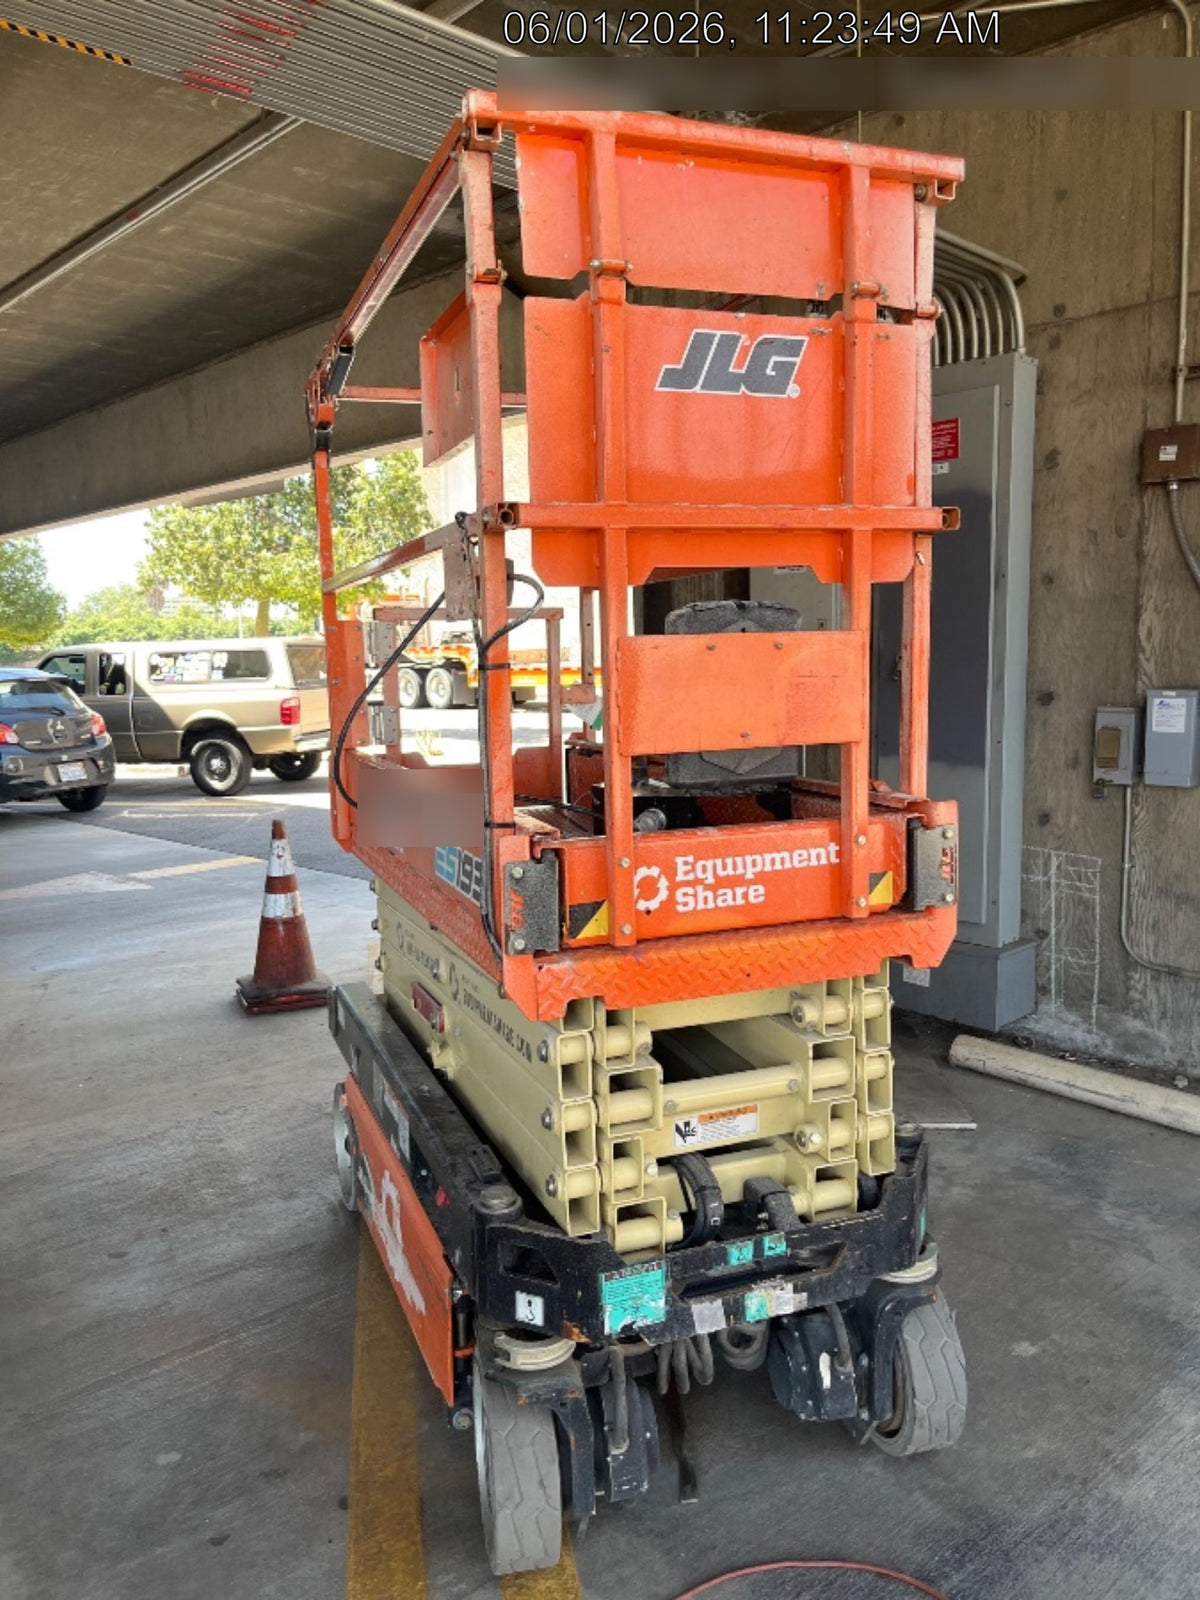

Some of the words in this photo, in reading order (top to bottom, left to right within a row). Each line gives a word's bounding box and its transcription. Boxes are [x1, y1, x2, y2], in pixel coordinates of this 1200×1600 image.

[654, 328, 809, 398] JLG
[674, 842, 840, 884] Equipment
[674, 883, 766, 913] Share
